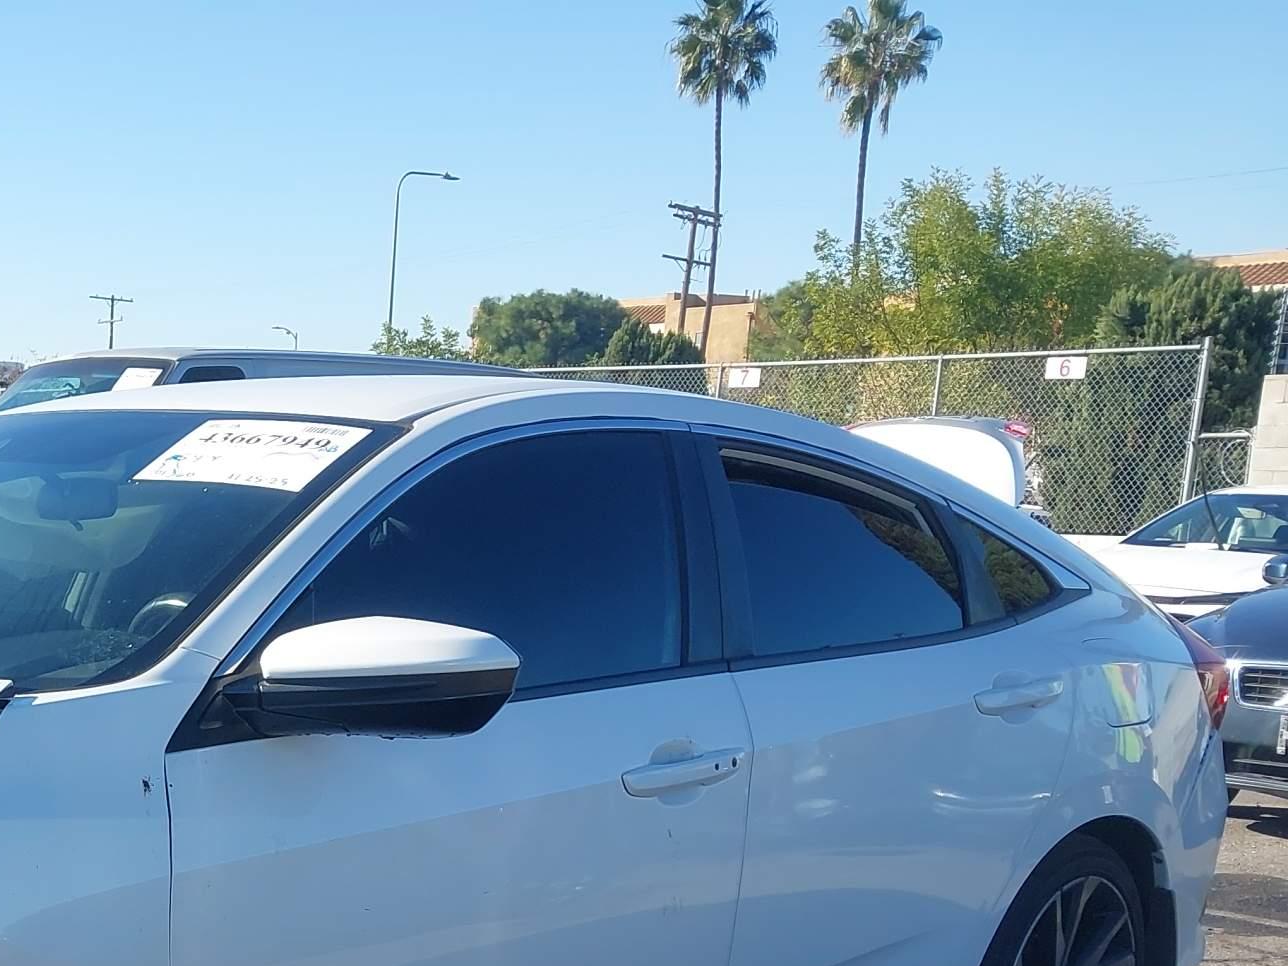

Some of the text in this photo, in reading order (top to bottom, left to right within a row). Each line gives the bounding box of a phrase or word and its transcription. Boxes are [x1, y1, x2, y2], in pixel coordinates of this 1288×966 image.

[740, 369, 750, 386] 7
[1060, 359, 1071, 378] 6
[198, 432, 332, 450] 43667949
